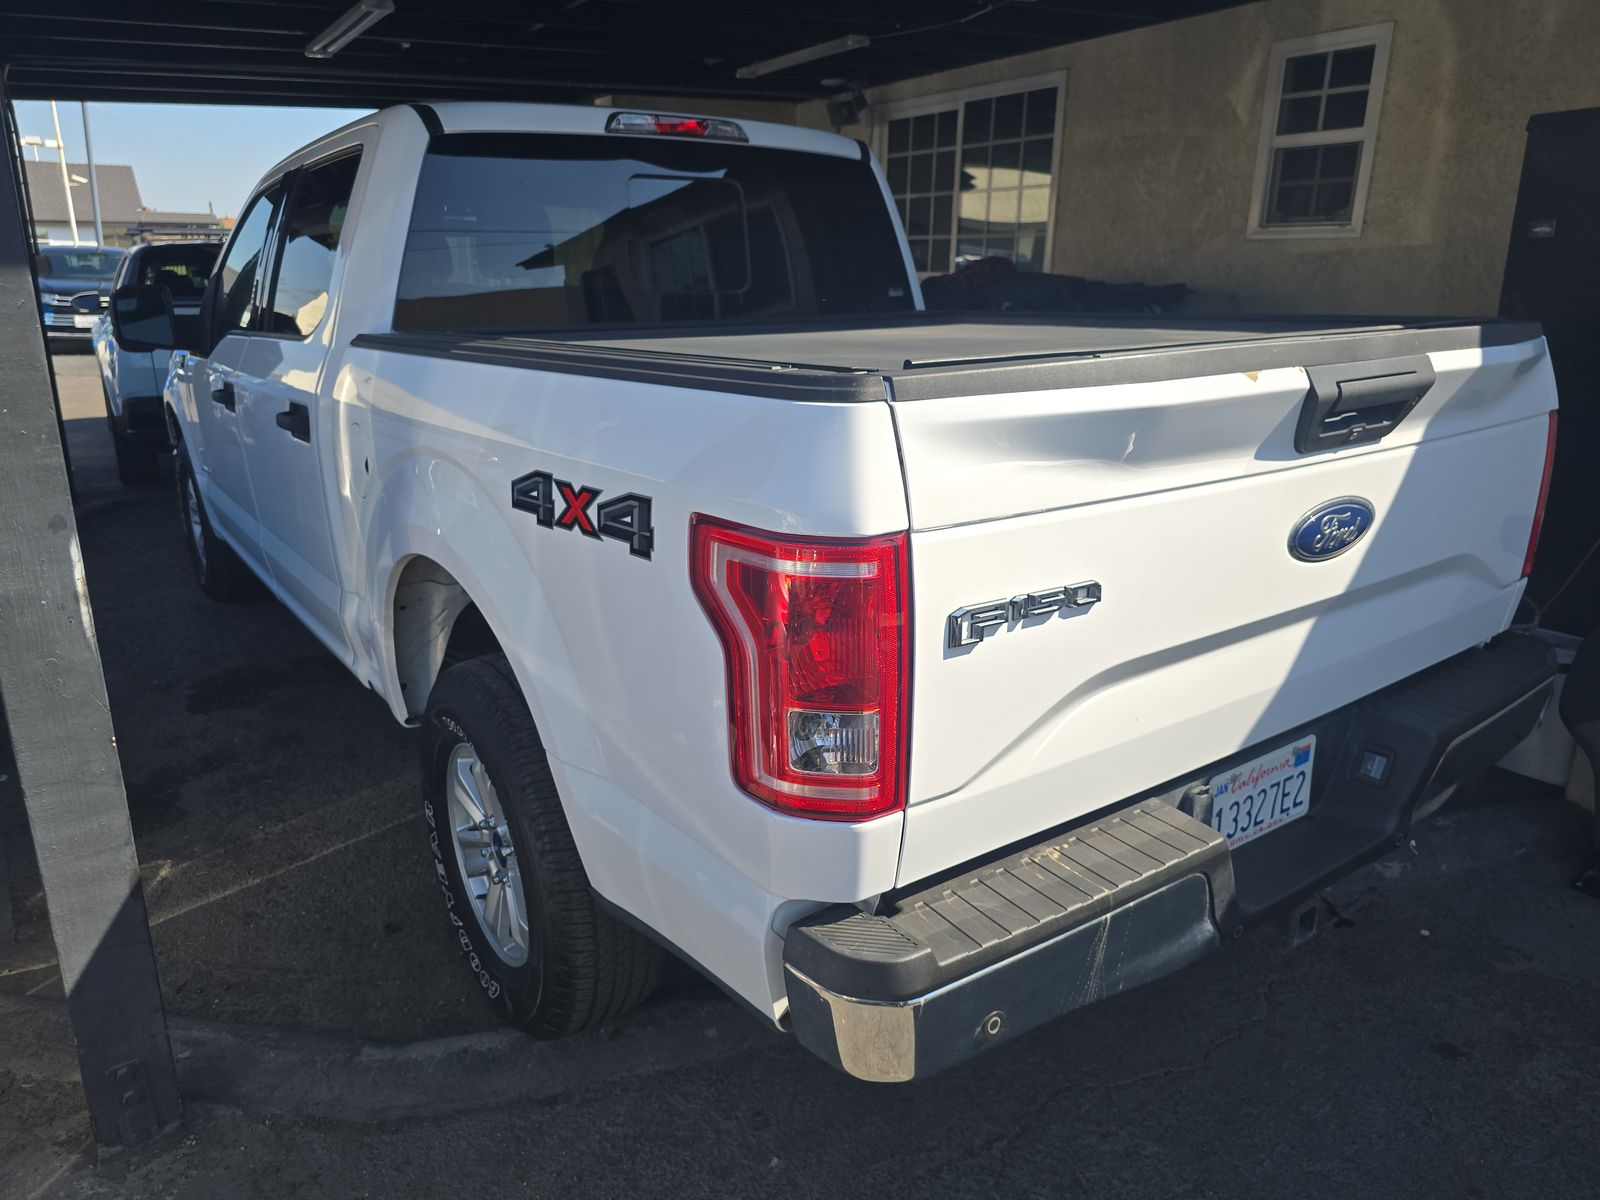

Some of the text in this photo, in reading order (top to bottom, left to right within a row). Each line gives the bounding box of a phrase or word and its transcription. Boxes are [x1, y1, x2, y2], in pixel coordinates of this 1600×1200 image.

[1311, 511, 1361, 553] Ford
[1215, 782, 1229, 798] JAN
[1231, 757, 1295, 793] California
[1215, 770, 1306, 839] 13327E2
[425, 799, 500, 999] GOODYEAR
